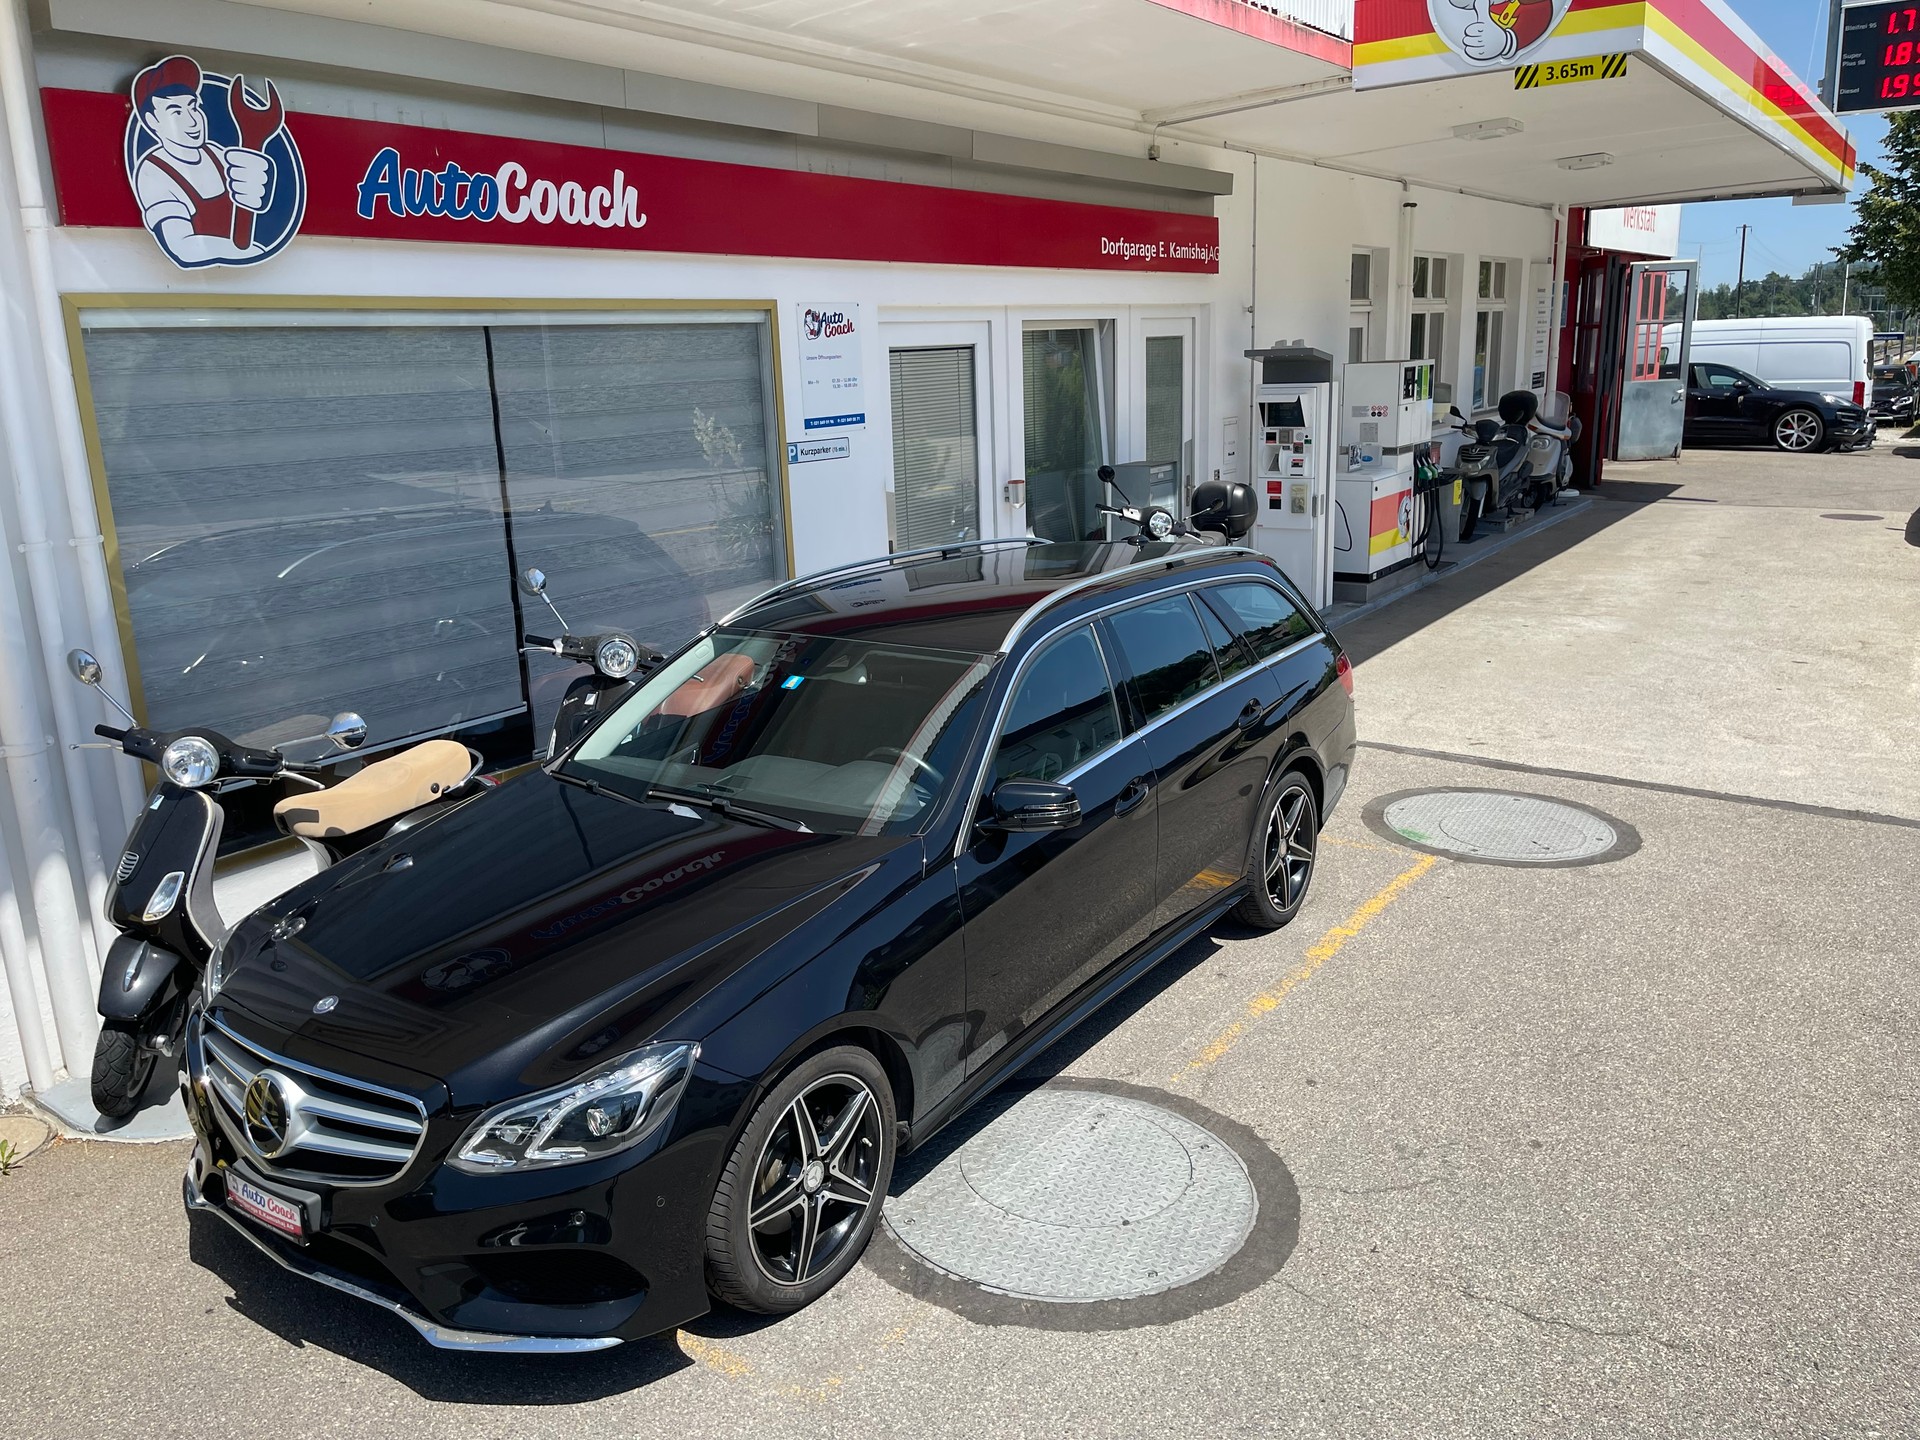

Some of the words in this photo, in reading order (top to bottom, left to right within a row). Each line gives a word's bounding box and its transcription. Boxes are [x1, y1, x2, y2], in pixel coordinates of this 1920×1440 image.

[1845, 23, 1867, 31] Bleifrei
[1884, 41, 1920, 66] 1.8
[1546, 63, 1594, 81] 3.65m
[1840, 87, 1860, 95] Diesel
[1623, 206, 1656, 233] Werkstatt
[1101, 236, 1157, 262] Dorfgarage
[1159, 241, 1167, 258] E.
[1169, 241, 1209, 264] Kamishaj
[820, 311, 844, 328] Auto
[824, 318, 855, 338] Coach
[800, 446, 832, 457] Kurzparker
[242, 1183, 266, 1208] Auto
[267, 1197, 297, 1221] Coach
